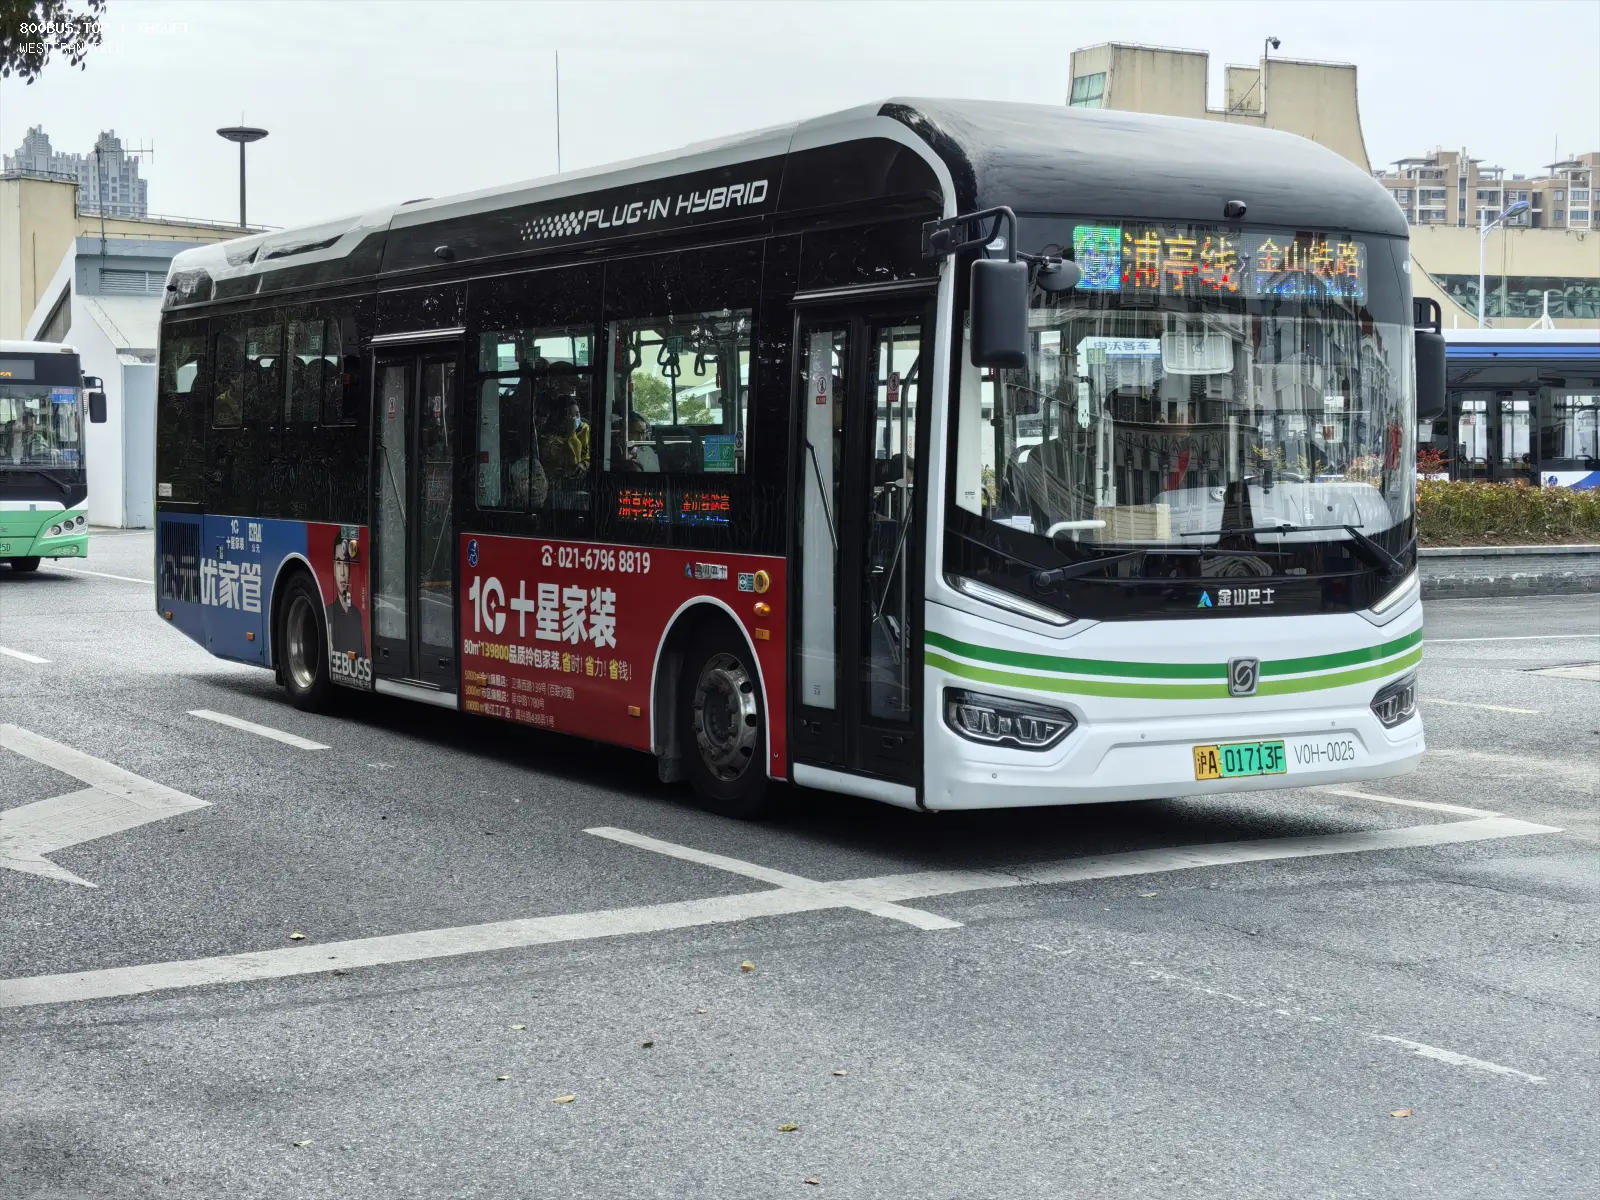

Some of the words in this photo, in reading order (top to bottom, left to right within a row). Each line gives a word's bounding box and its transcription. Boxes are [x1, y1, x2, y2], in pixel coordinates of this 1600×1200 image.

[675, 179, 769, 217] HYBRID
[558, 546, 616, 571] 021-6796
[618, 550, 651, 574] 8819
[1217, 588, 1276, 607] 金山巴士
[510, 579, 617, 649] 十星家装
[1197, 751, 1218, 775] 沪A
[1224, 744, 1283, 773] 01713F
